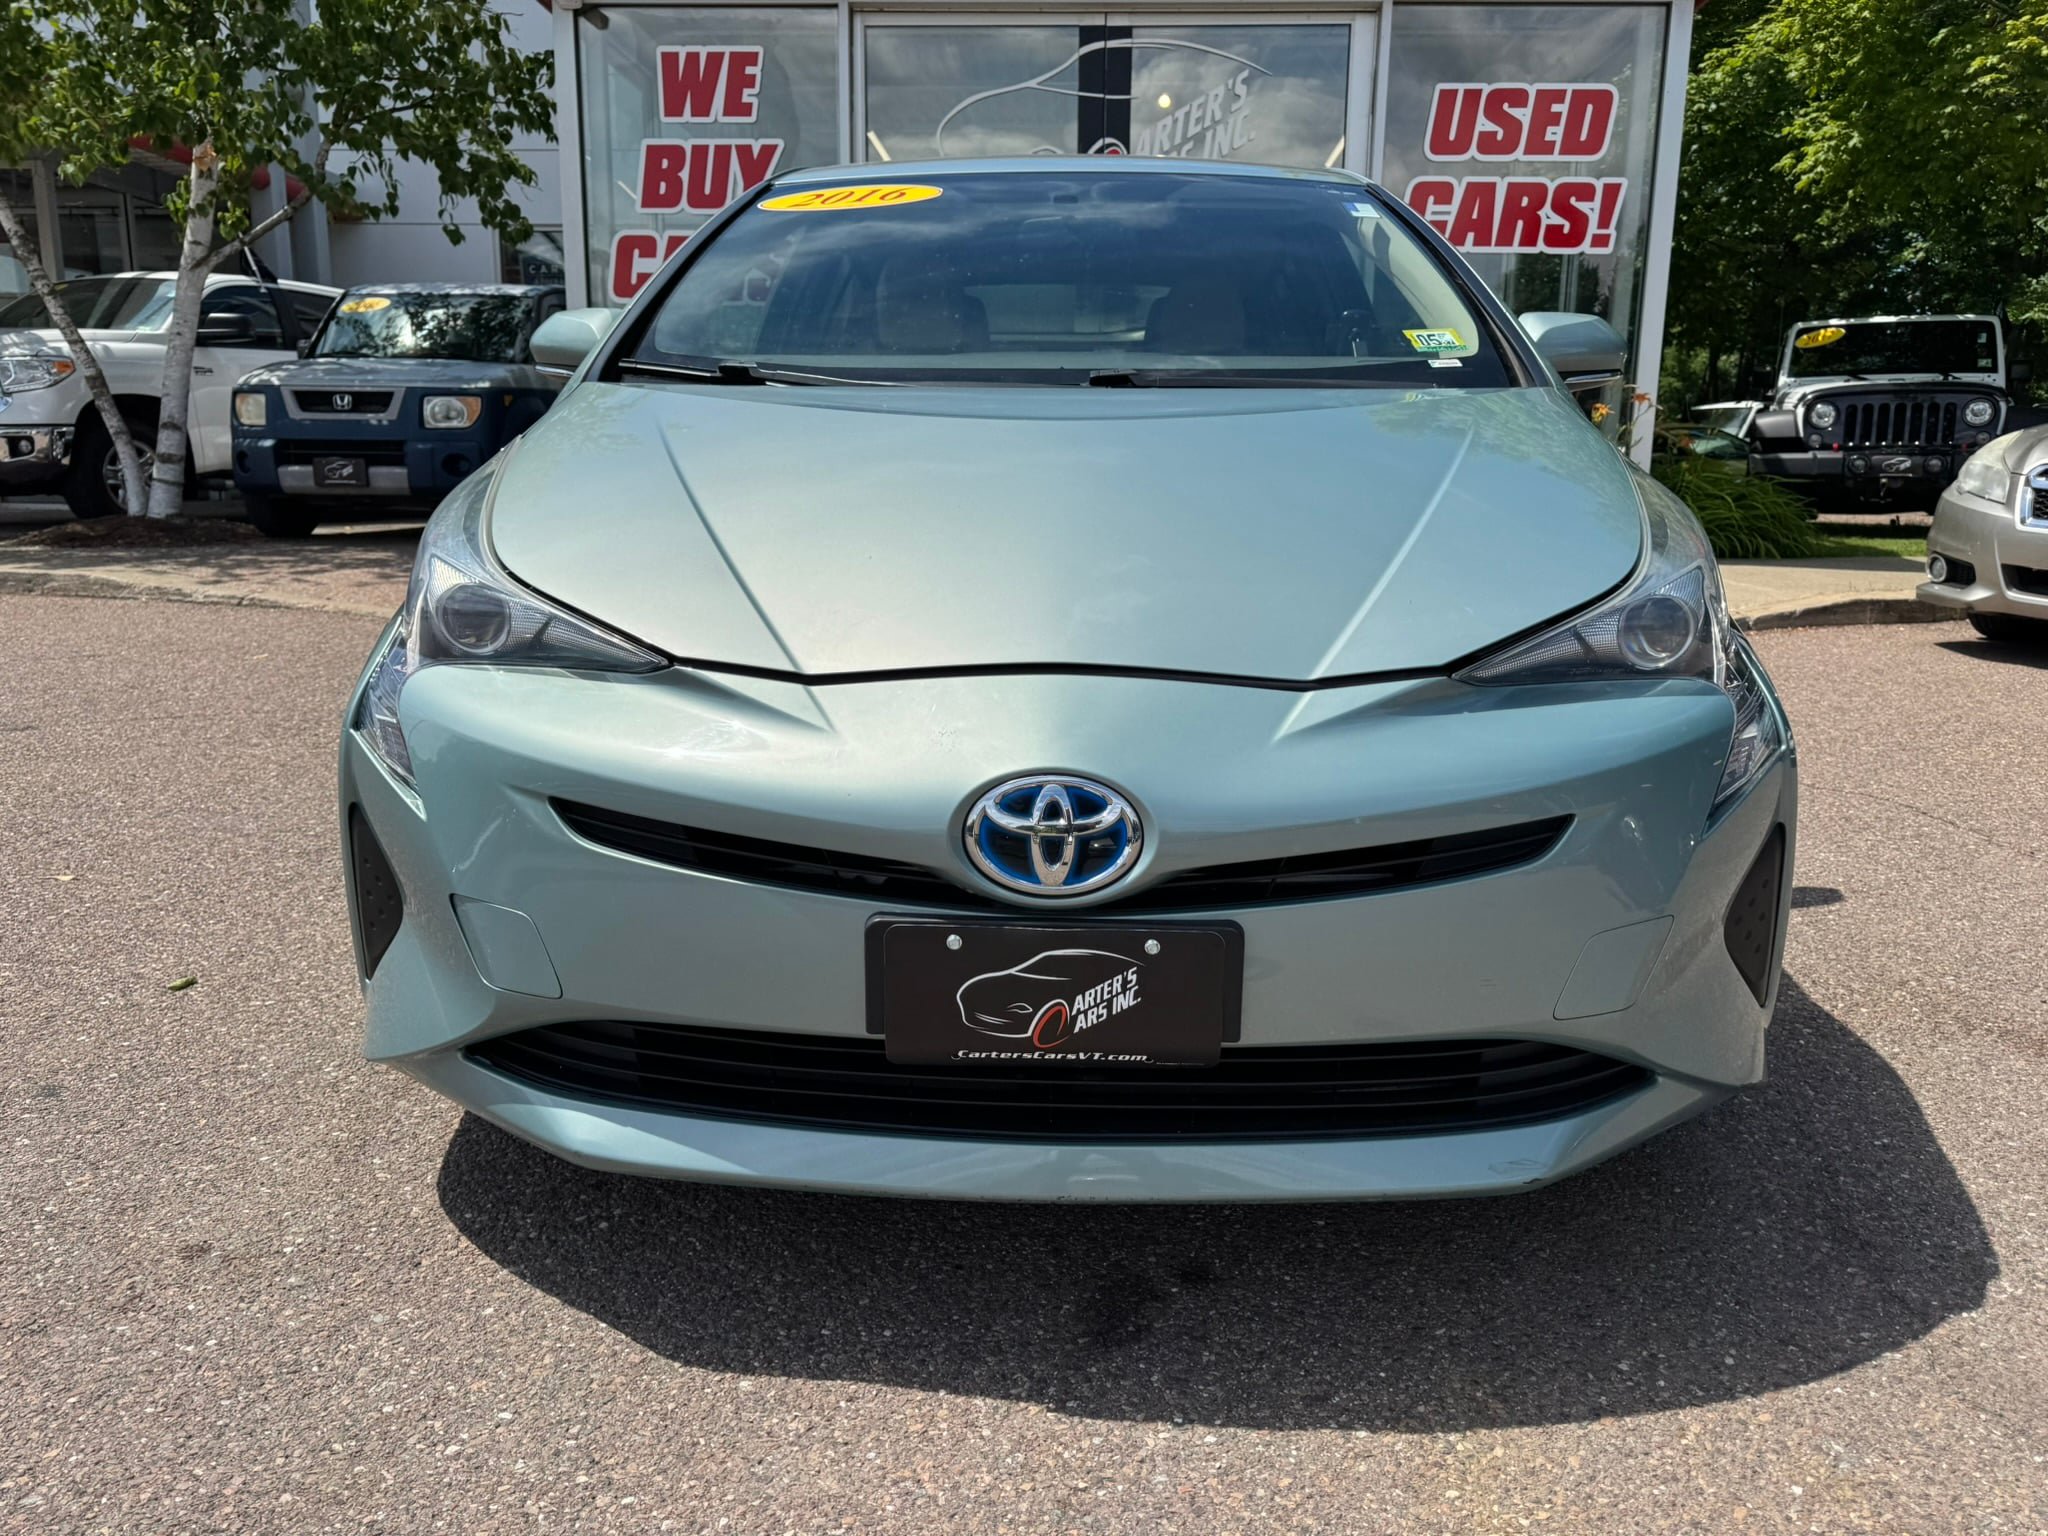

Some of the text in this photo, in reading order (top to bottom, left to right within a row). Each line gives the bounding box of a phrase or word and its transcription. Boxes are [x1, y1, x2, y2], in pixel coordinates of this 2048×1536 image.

[660, 50, 760, 118] WE
[1428, 87, 1615, 156] USED
[640, 143, 779, 209] BUY
[787, 187, 916, 208] 2016
[1407, 180, 1623, 249] CARS!
[1112, 985, 1142, 1015] INC.
[952, 1049, 1153, 1063] CartersCarsVT.com
